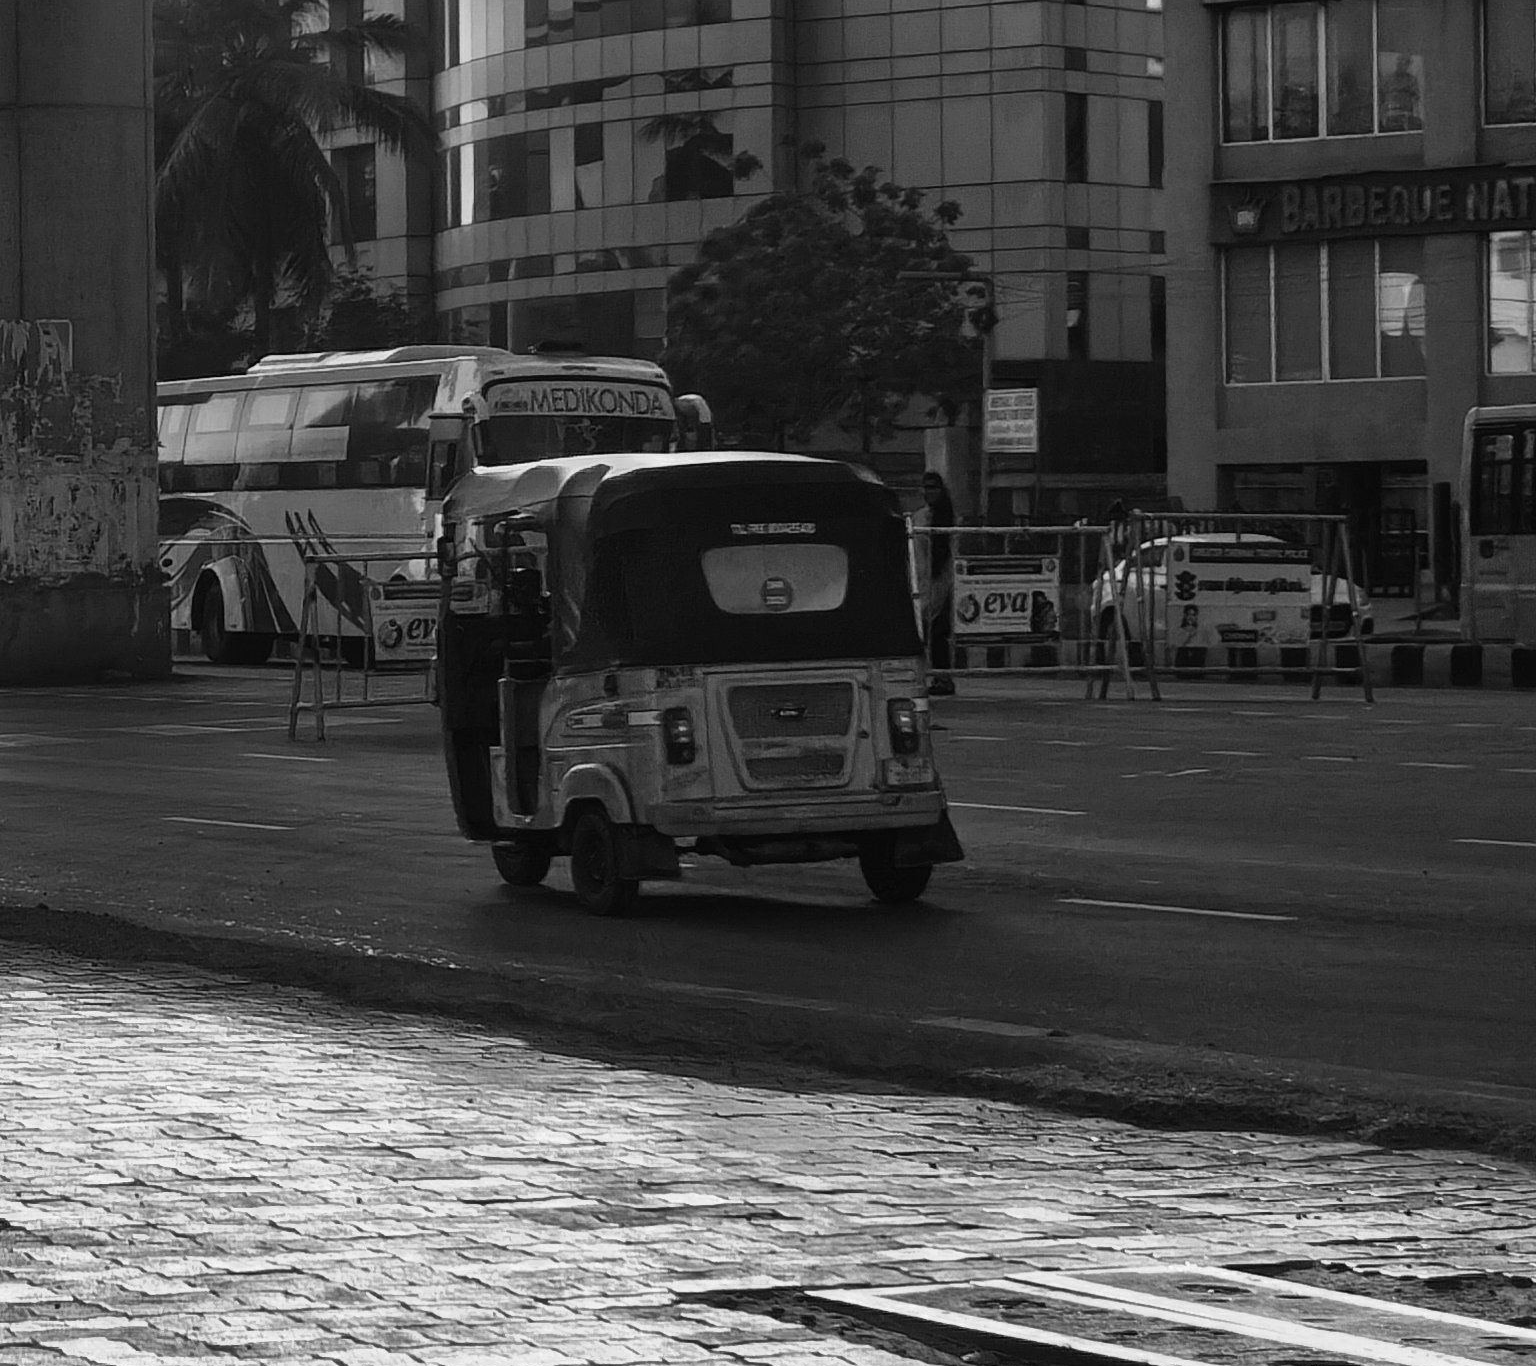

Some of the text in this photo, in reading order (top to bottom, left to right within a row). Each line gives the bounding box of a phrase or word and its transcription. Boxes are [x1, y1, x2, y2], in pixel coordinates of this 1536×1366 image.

[1281, 176, 1536, 233] BARBEQUE NAT
[530, 387, 668, 416] MEDIKONDA
[984, 591, 1028, 614] eva
